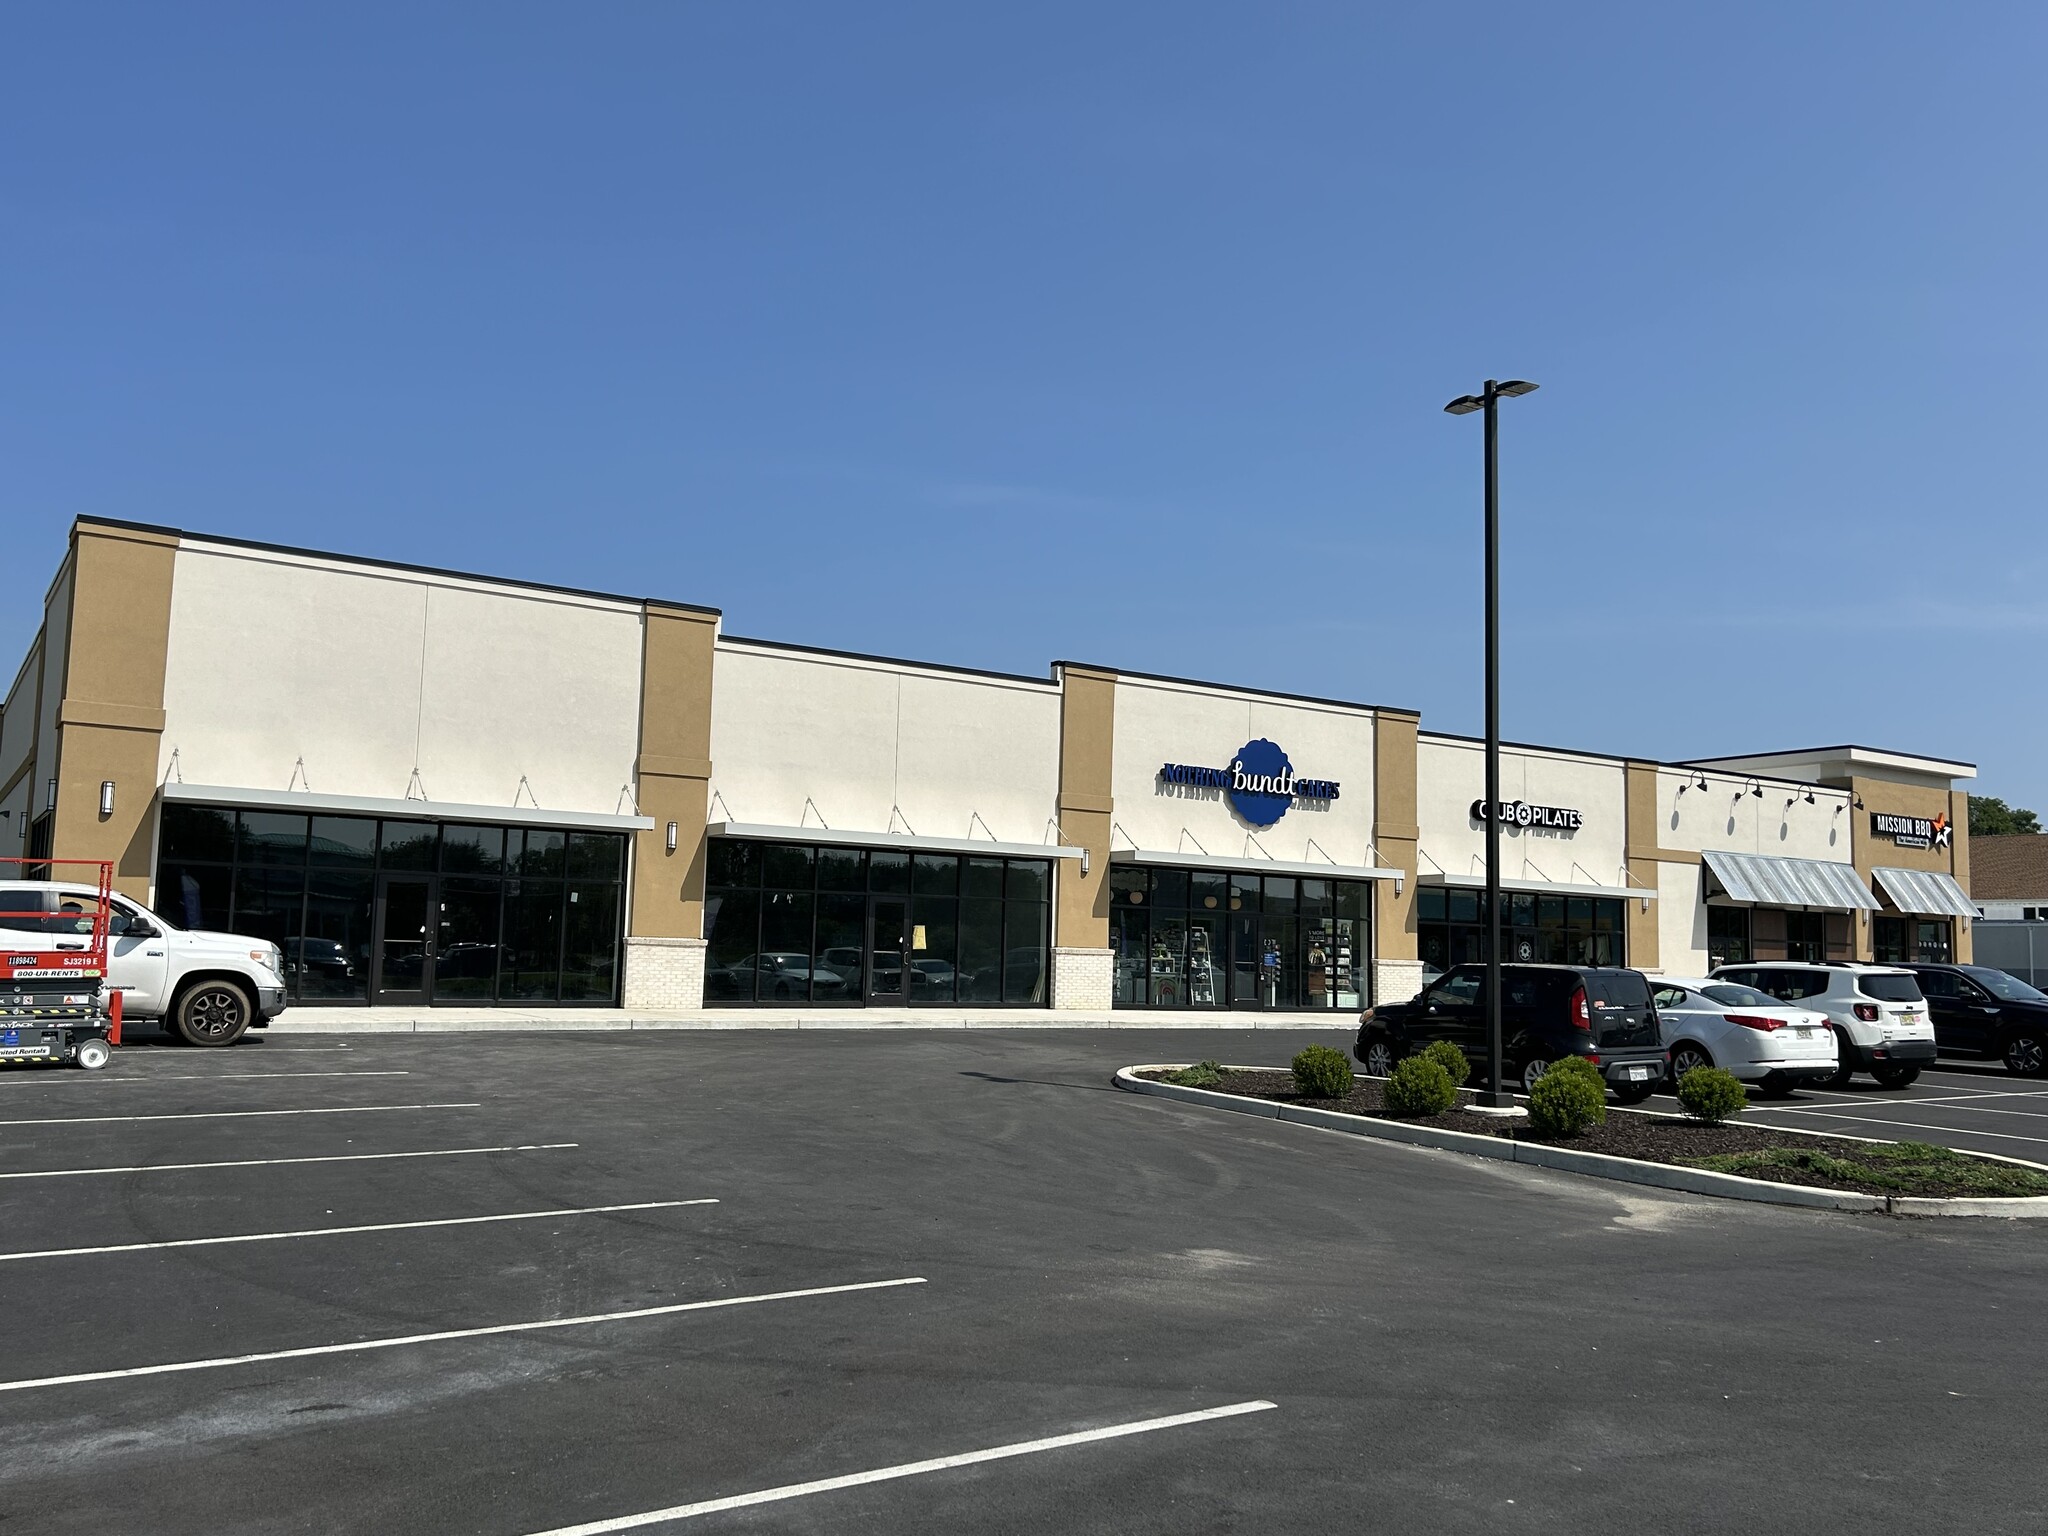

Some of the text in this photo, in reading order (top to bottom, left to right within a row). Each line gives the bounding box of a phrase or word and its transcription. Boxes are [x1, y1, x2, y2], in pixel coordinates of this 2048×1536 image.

[1161, 760, 1340, 799] NOTHING bundt CAKES
[1479, 801, 1584, 828] CUB PILATES
[1877, 815, 1932, 838] MISSION BBQ
[63, 957, 92, 966] SJ3219
[19, 1048, 47, 1056] Rentals
